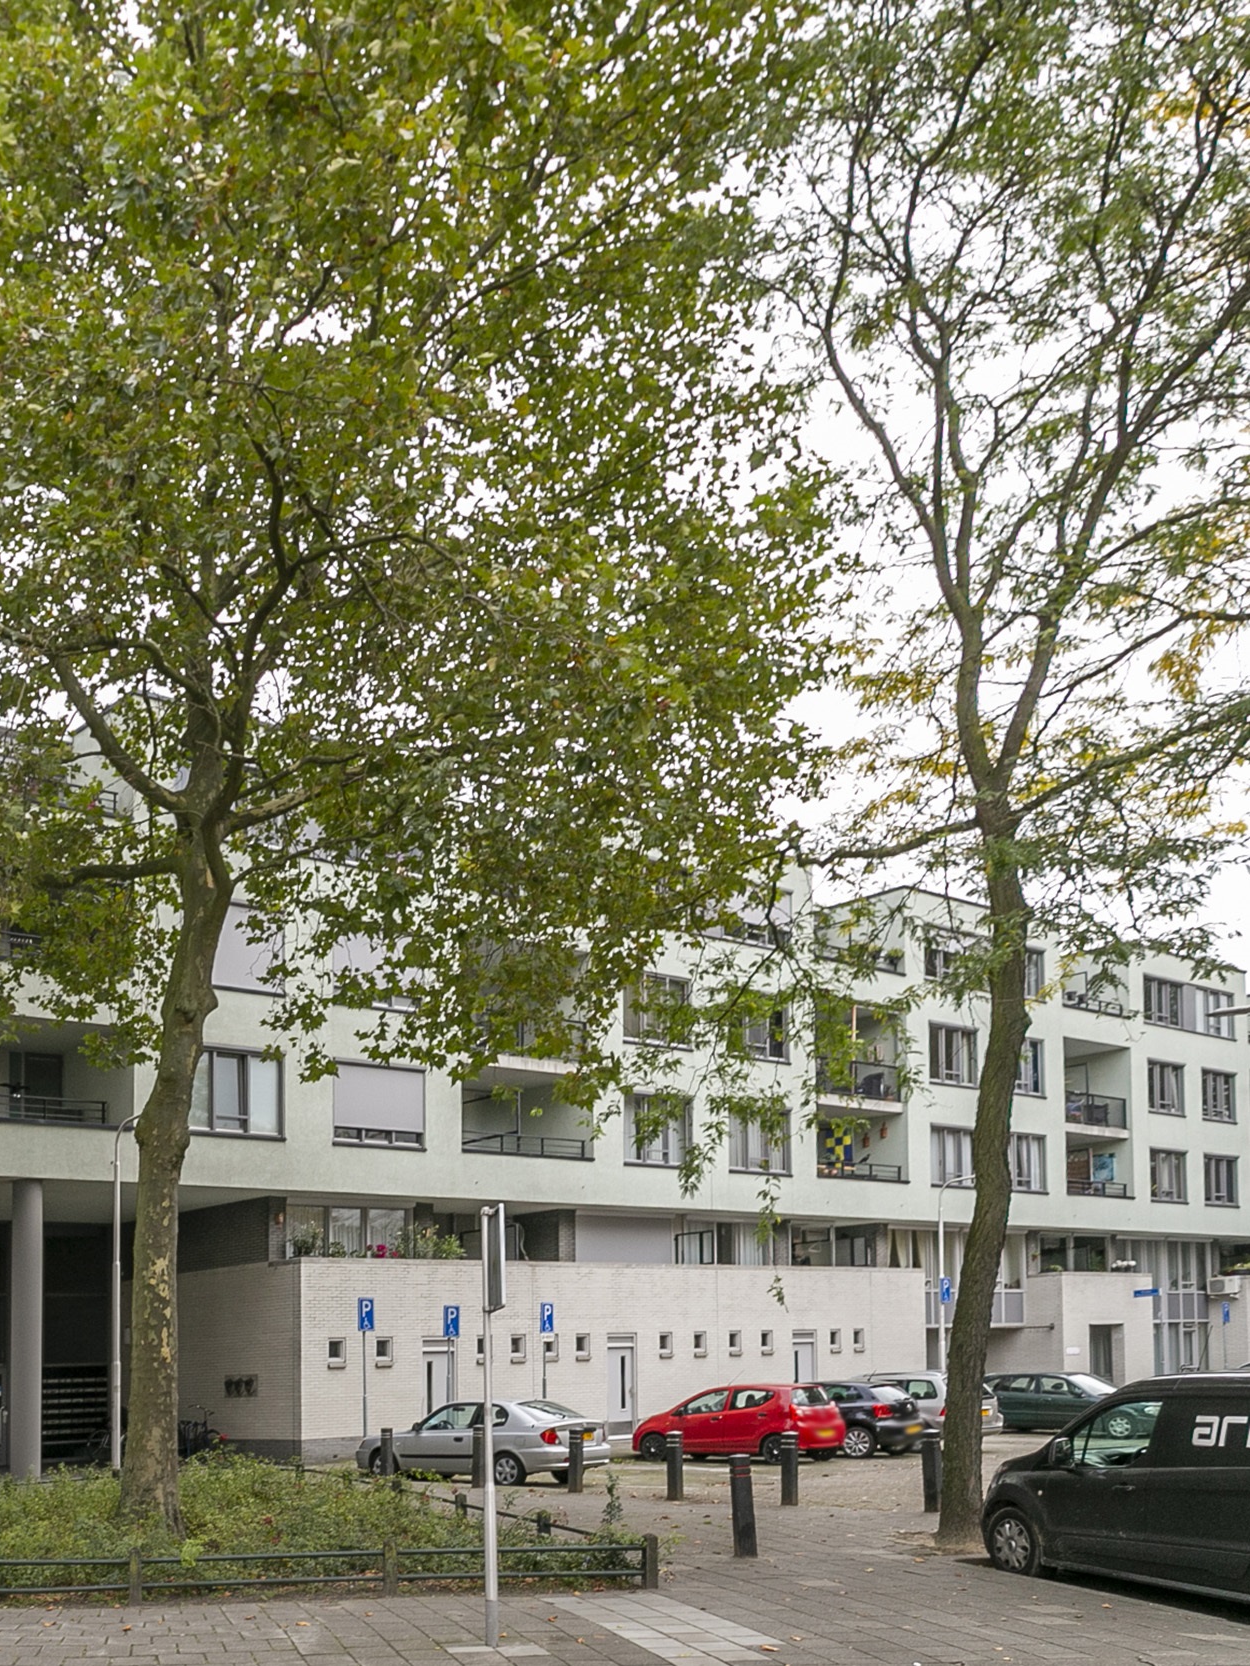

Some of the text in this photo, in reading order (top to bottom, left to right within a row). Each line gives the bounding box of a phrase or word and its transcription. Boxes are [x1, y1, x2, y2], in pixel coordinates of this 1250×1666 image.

[362, 1301, 371, 1317] P
[448, 1308, 457, 1324] P
[544, 1305, 551, 1320] P
[1192, 1415, 1250, 1448] ar
